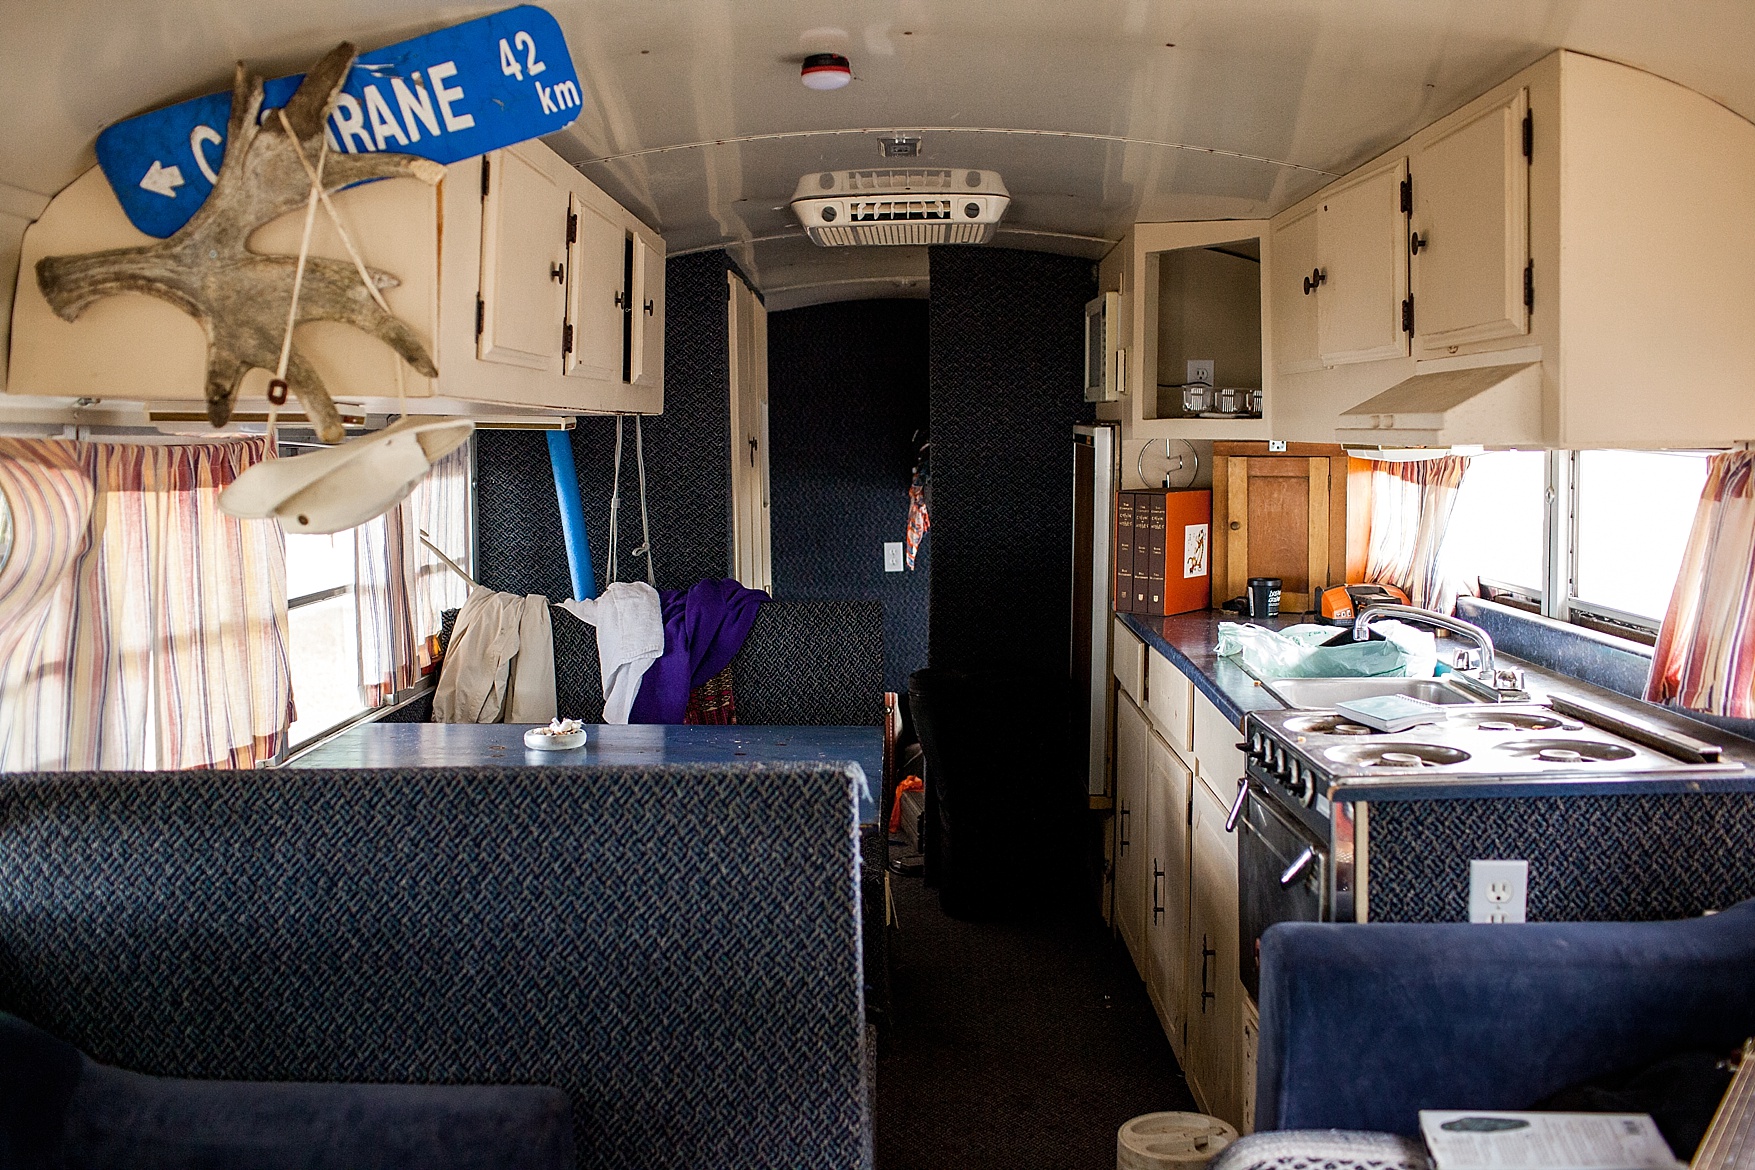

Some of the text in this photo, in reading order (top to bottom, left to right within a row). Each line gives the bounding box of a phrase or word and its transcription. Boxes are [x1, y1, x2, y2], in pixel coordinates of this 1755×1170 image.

[498, 30, 546, 82] 42
[534, 78, 580, 115] km
[190, 61, 475, 186] CRANE
